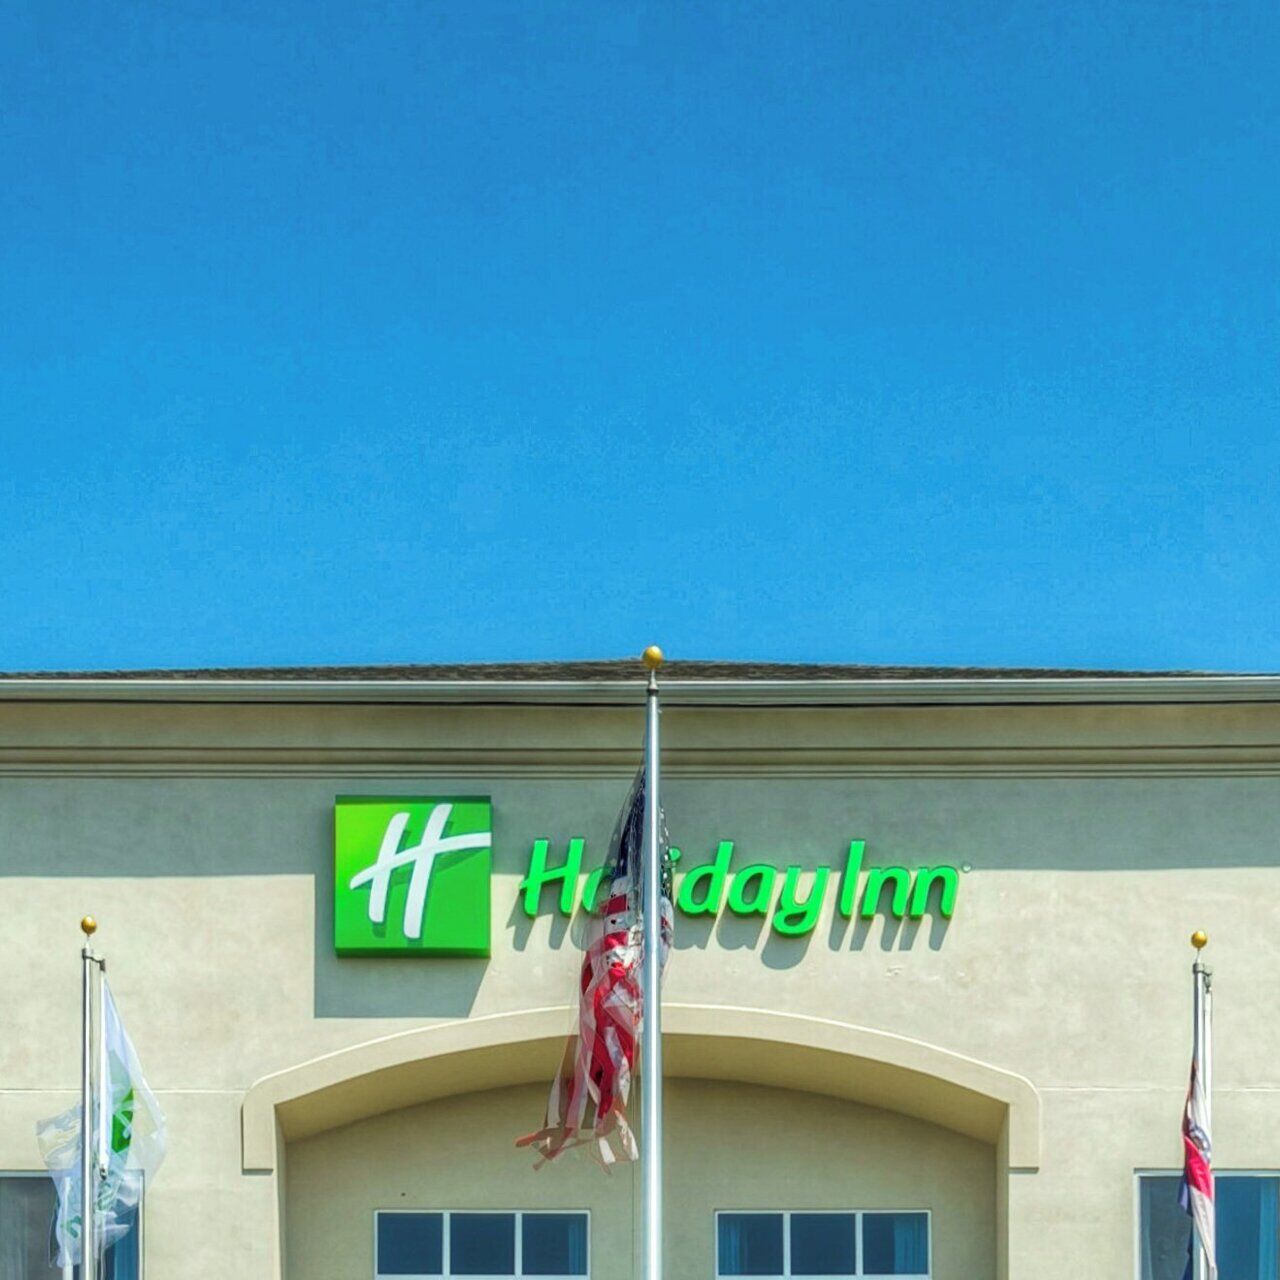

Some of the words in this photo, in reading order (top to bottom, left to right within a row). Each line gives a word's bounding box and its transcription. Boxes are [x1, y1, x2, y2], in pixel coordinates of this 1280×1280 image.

[349, 803, 491, 939] H
[519, 837, 831, 936] Hoday
[839, 839, 959, 919] Inn
